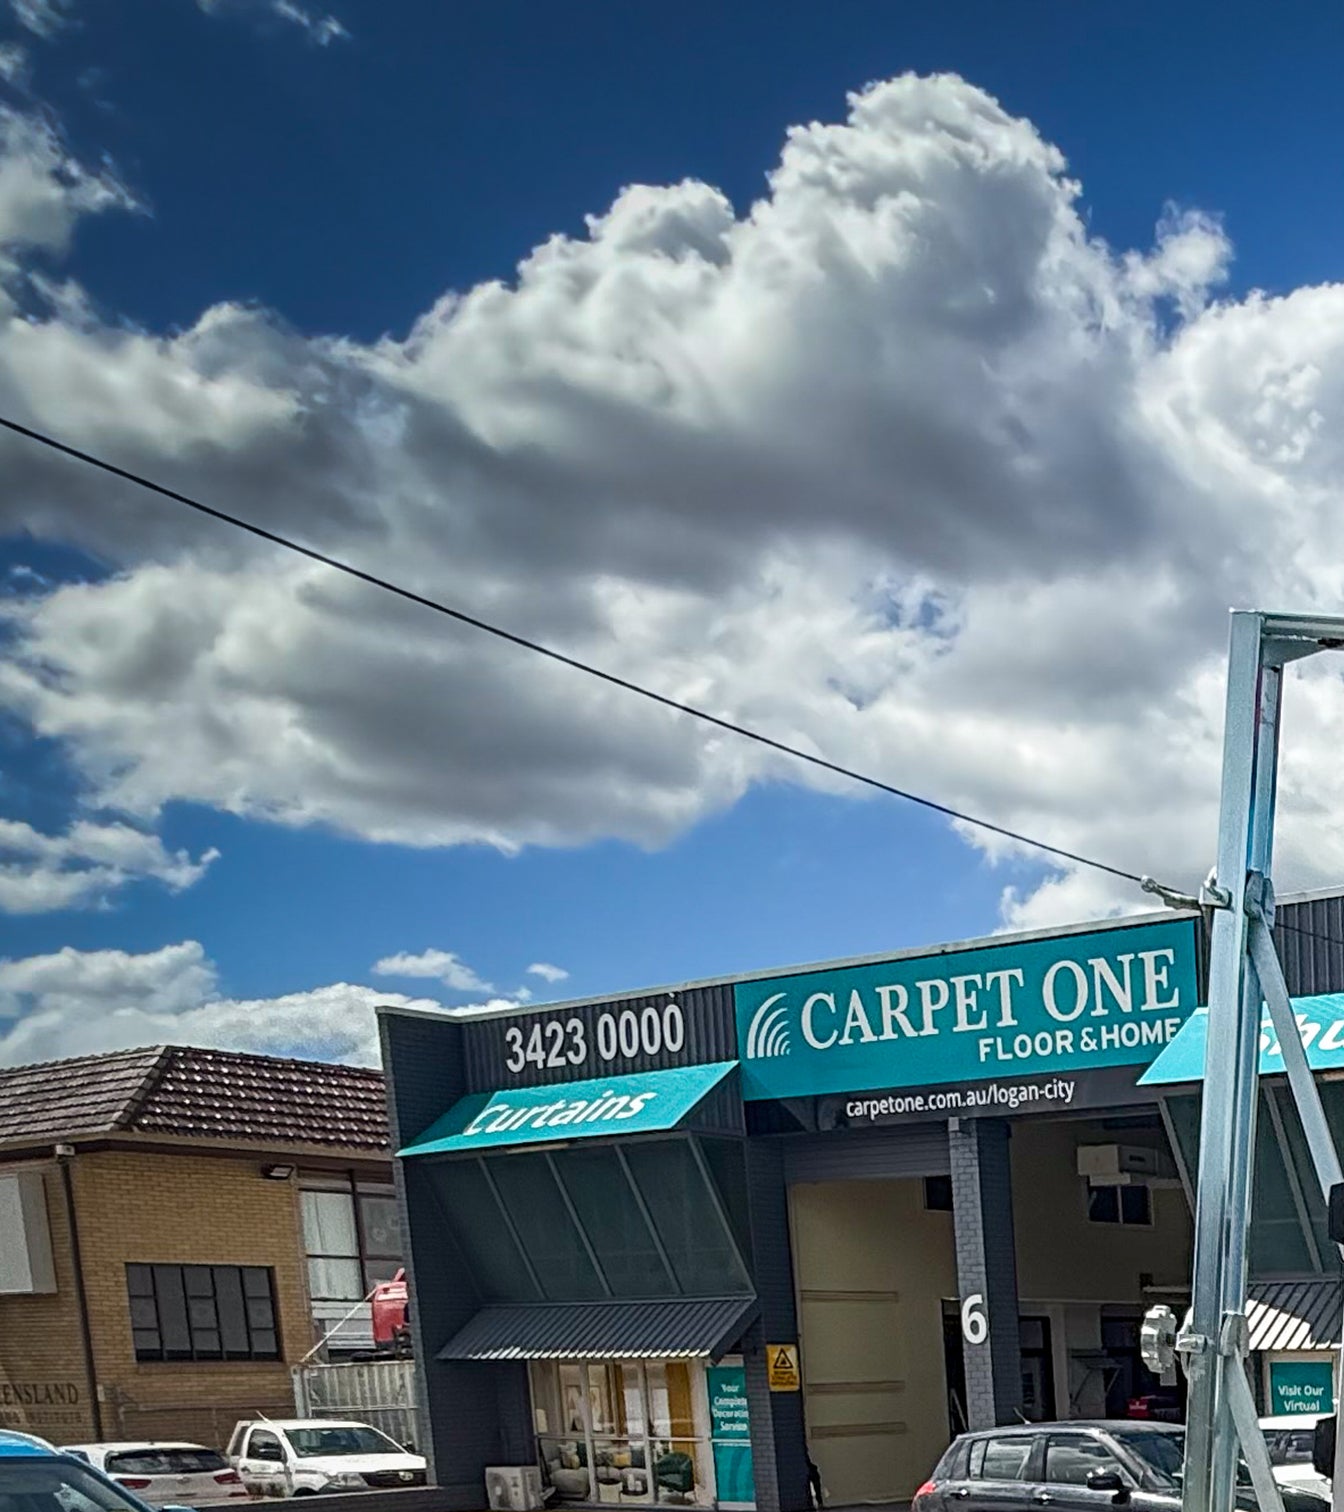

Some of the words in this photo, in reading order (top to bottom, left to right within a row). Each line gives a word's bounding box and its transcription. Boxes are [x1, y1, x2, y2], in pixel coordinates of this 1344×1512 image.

[801, 968, 1024, 1050] CARPET
[1042, 948, 1180, 1023] ONE
[506, 1017, 588, 1073] 3423
[598, 1004, 684, 1060] 0000
[979, 1032, 1074, 1062] FLOOR
[1081, 1029, 1098, 1051] &
[1101, 1018, 1181, 1050] HOME
[463, 1091, 658, 1136] Curtains
[846, 1079, 1076, 1121] carpetone.com.au/logan-city
[962, 1294, 987, 1344] 6
[1278, 1385, 1300, 1396] Visit
[1304, 1385, 1324, 1396] Our
[1284, 1400, 1320, 1411] Virtual
